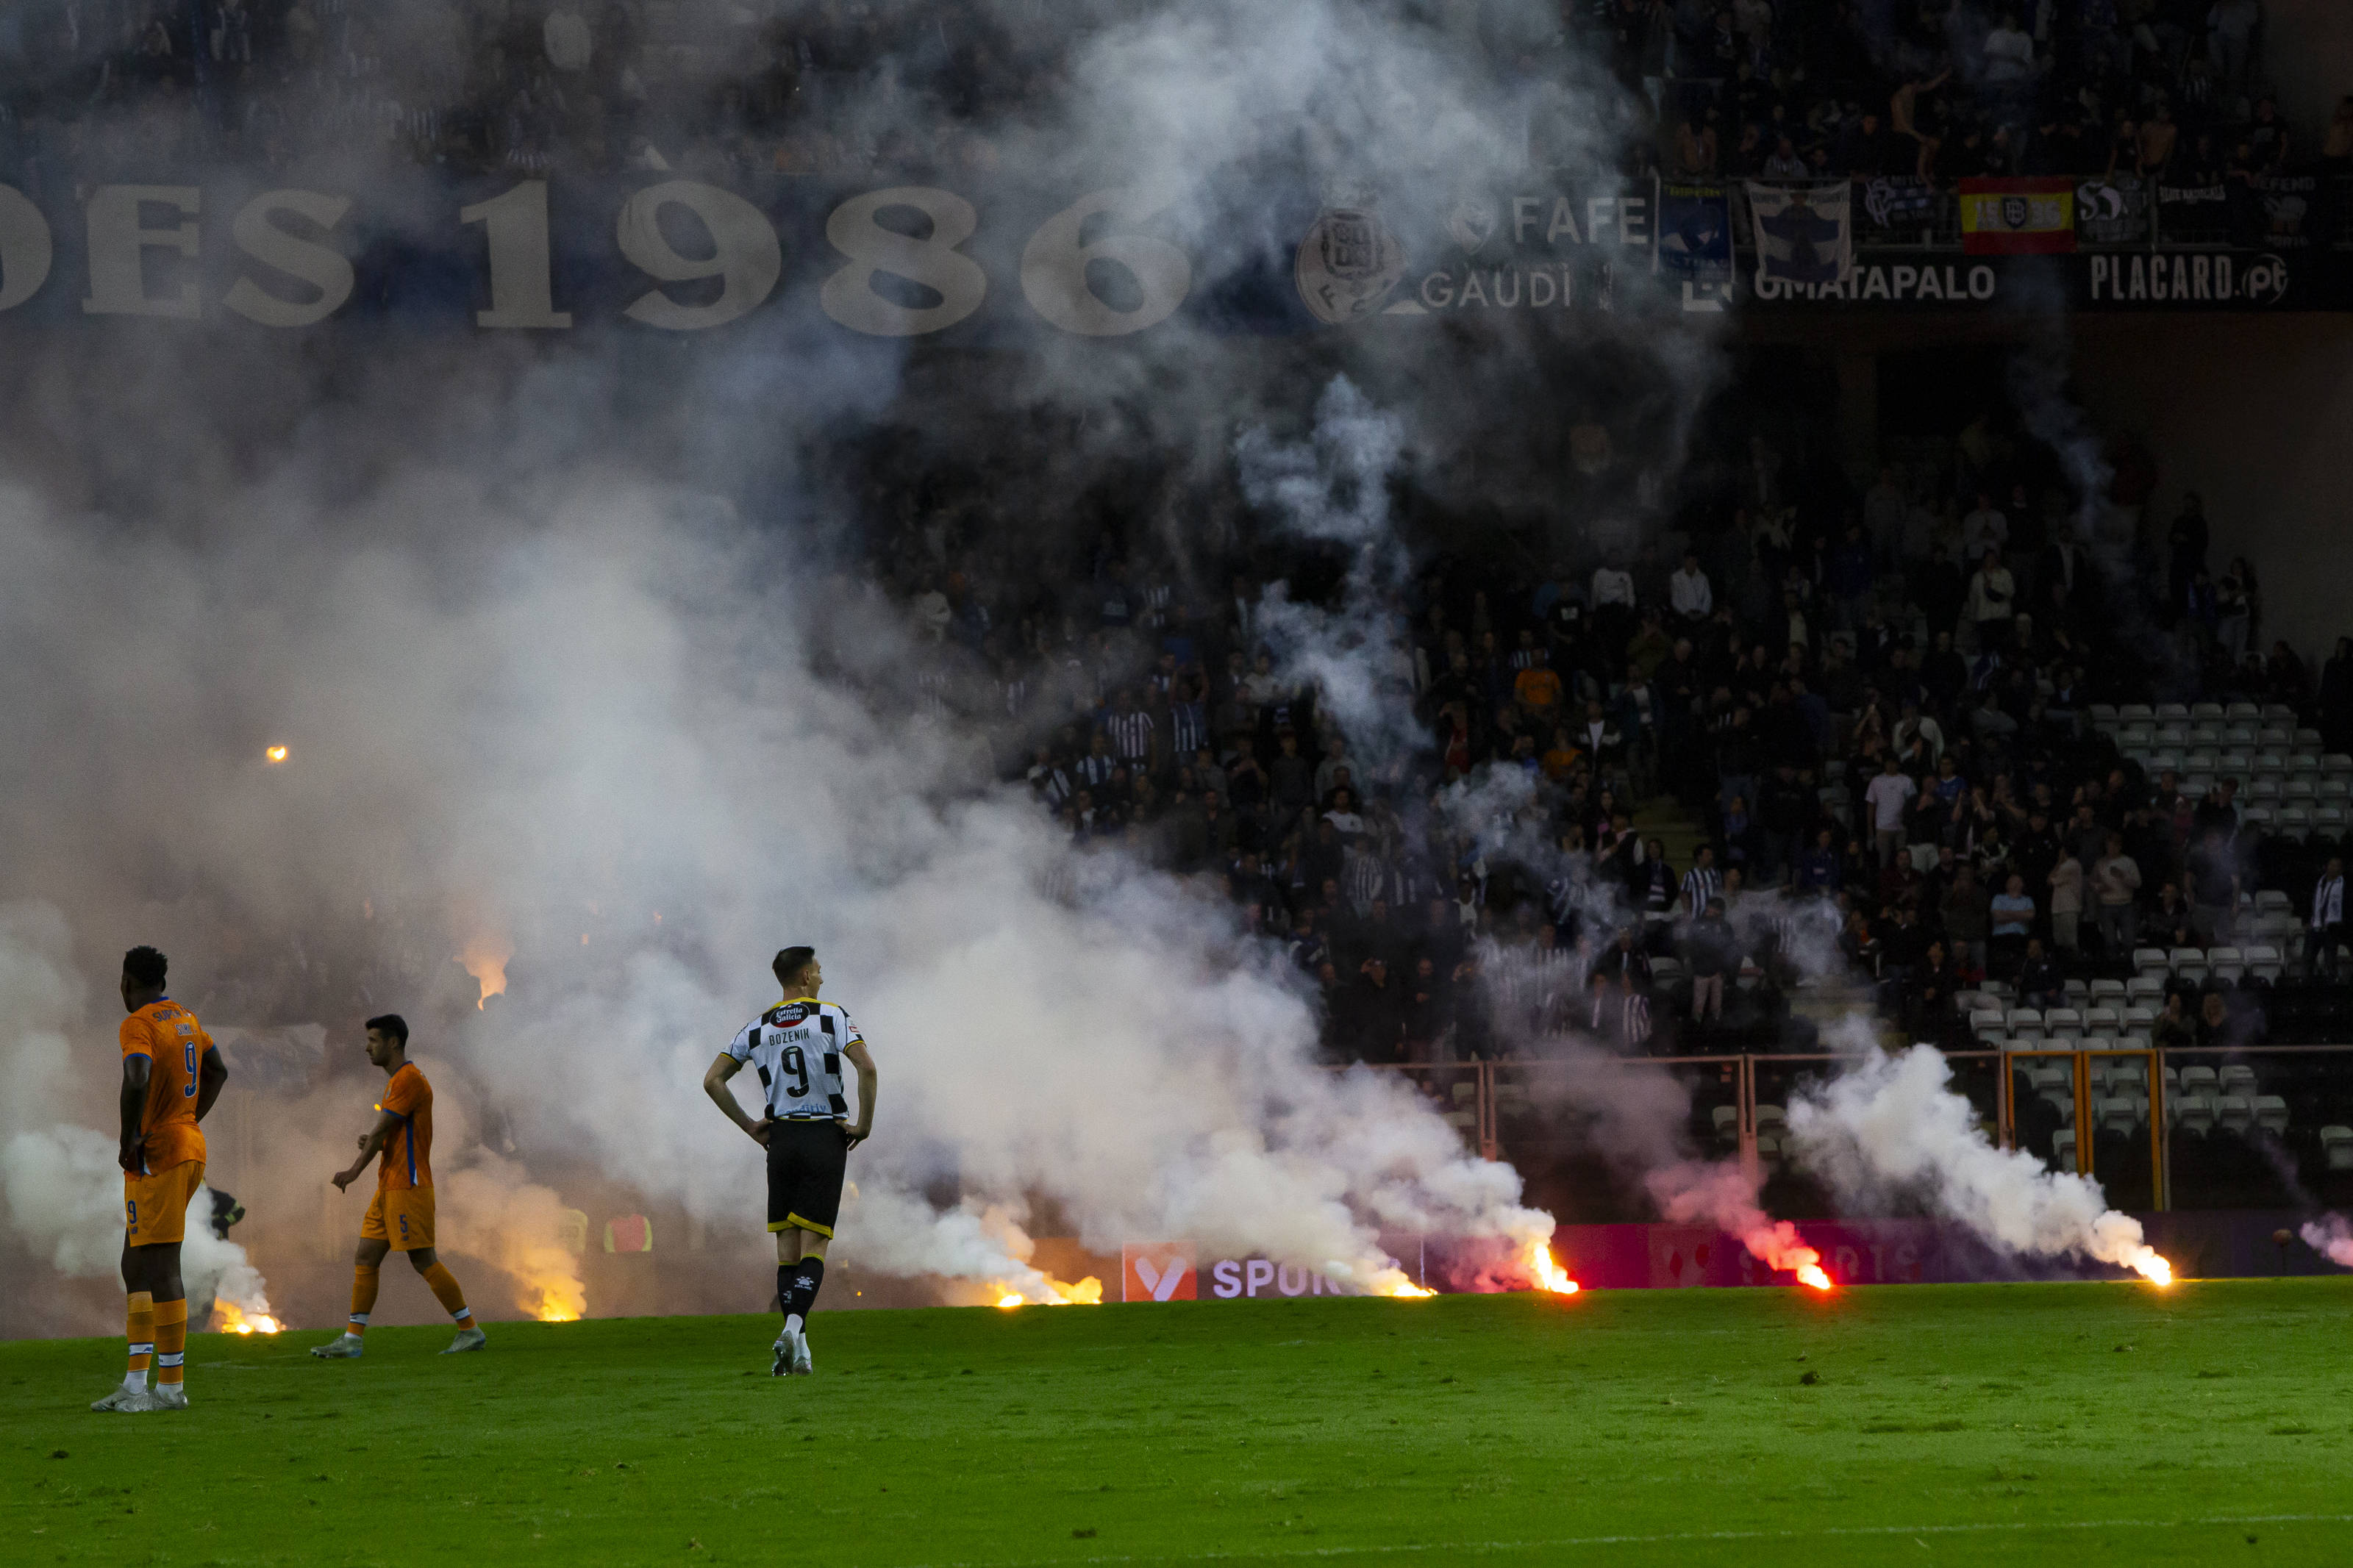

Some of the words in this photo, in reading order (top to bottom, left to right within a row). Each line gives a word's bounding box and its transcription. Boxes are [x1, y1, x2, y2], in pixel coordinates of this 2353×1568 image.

[460, 179, 1192, 337] 1986
[776, 1007, 803, 1017] Estrella
[776, 1014, 801, 1023] Galicia
[184, 1041, 197, 1098] 9
[781, 1045, 810, 1098] 9
[127, 1200, 138, 1225] 9
[399, 1214, 409, 1234] 5
